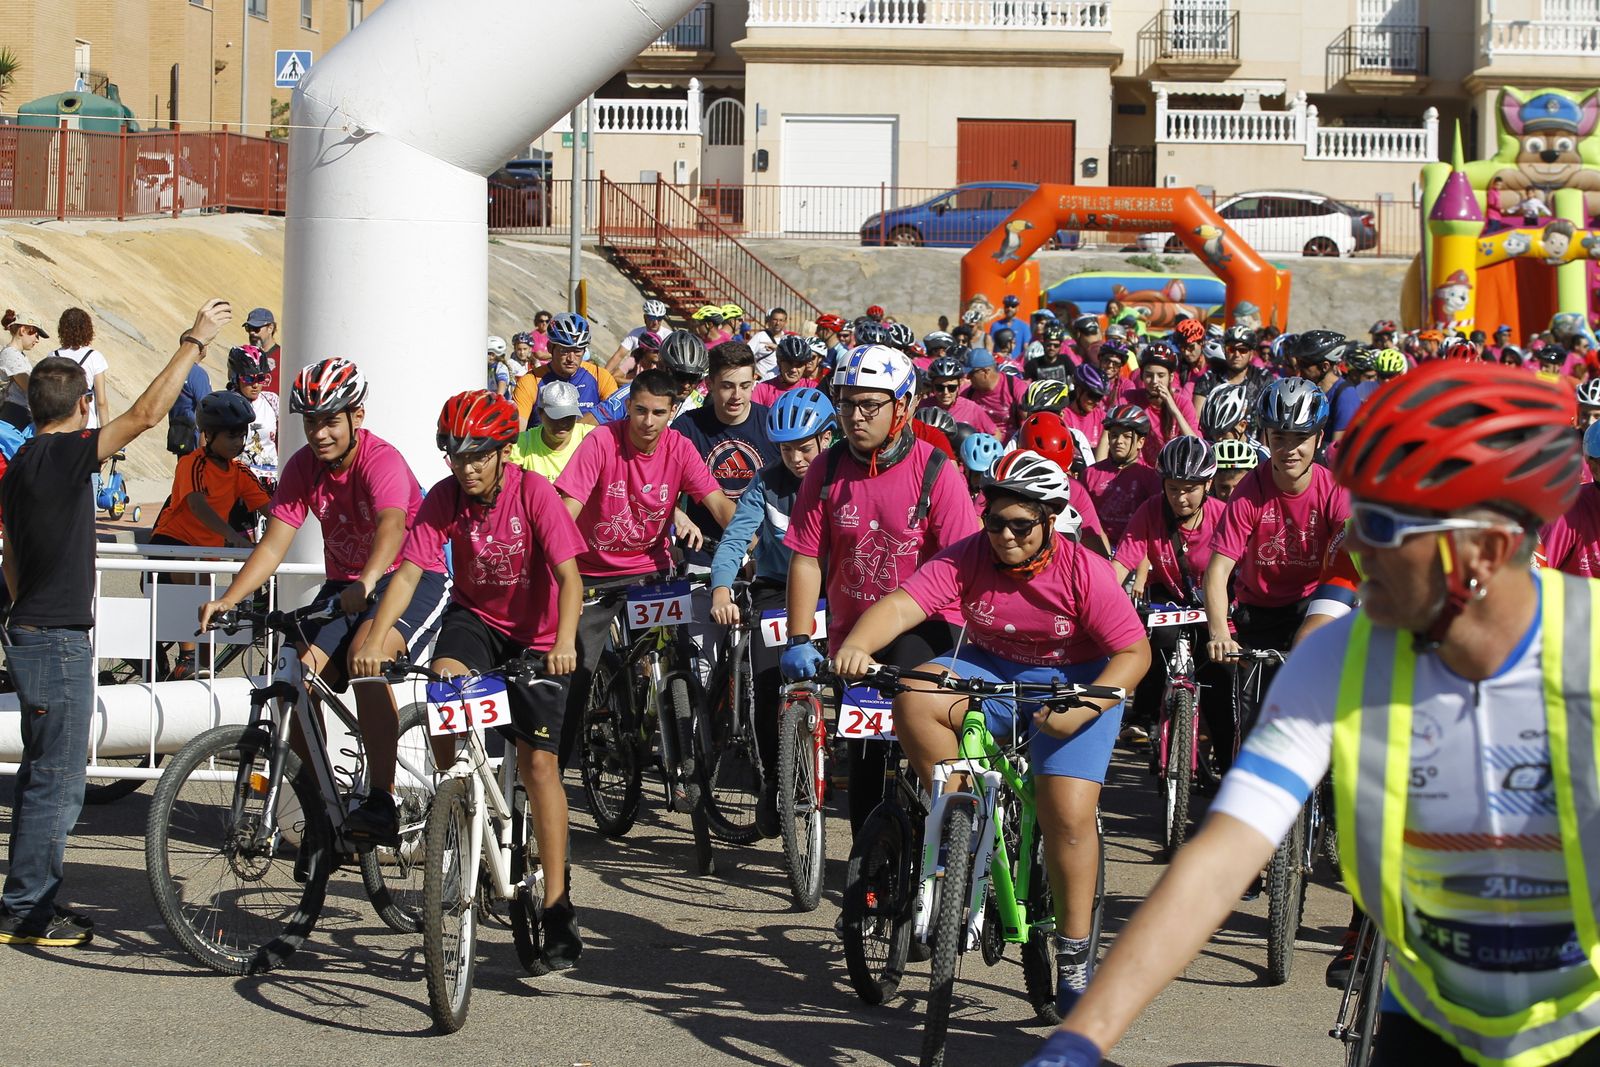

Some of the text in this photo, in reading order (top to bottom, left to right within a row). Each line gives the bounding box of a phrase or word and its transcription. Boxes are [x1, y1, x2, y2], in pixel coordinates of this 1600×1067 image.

[713, 468, 754, 479] adidas
[851, 590, 862, 599] DE
[864, 592, 876, 601] LA
[633, 600, 683, 625] 374
[1154, 611, 1200, 625] 319
[438, 699, 499, 731] 213
